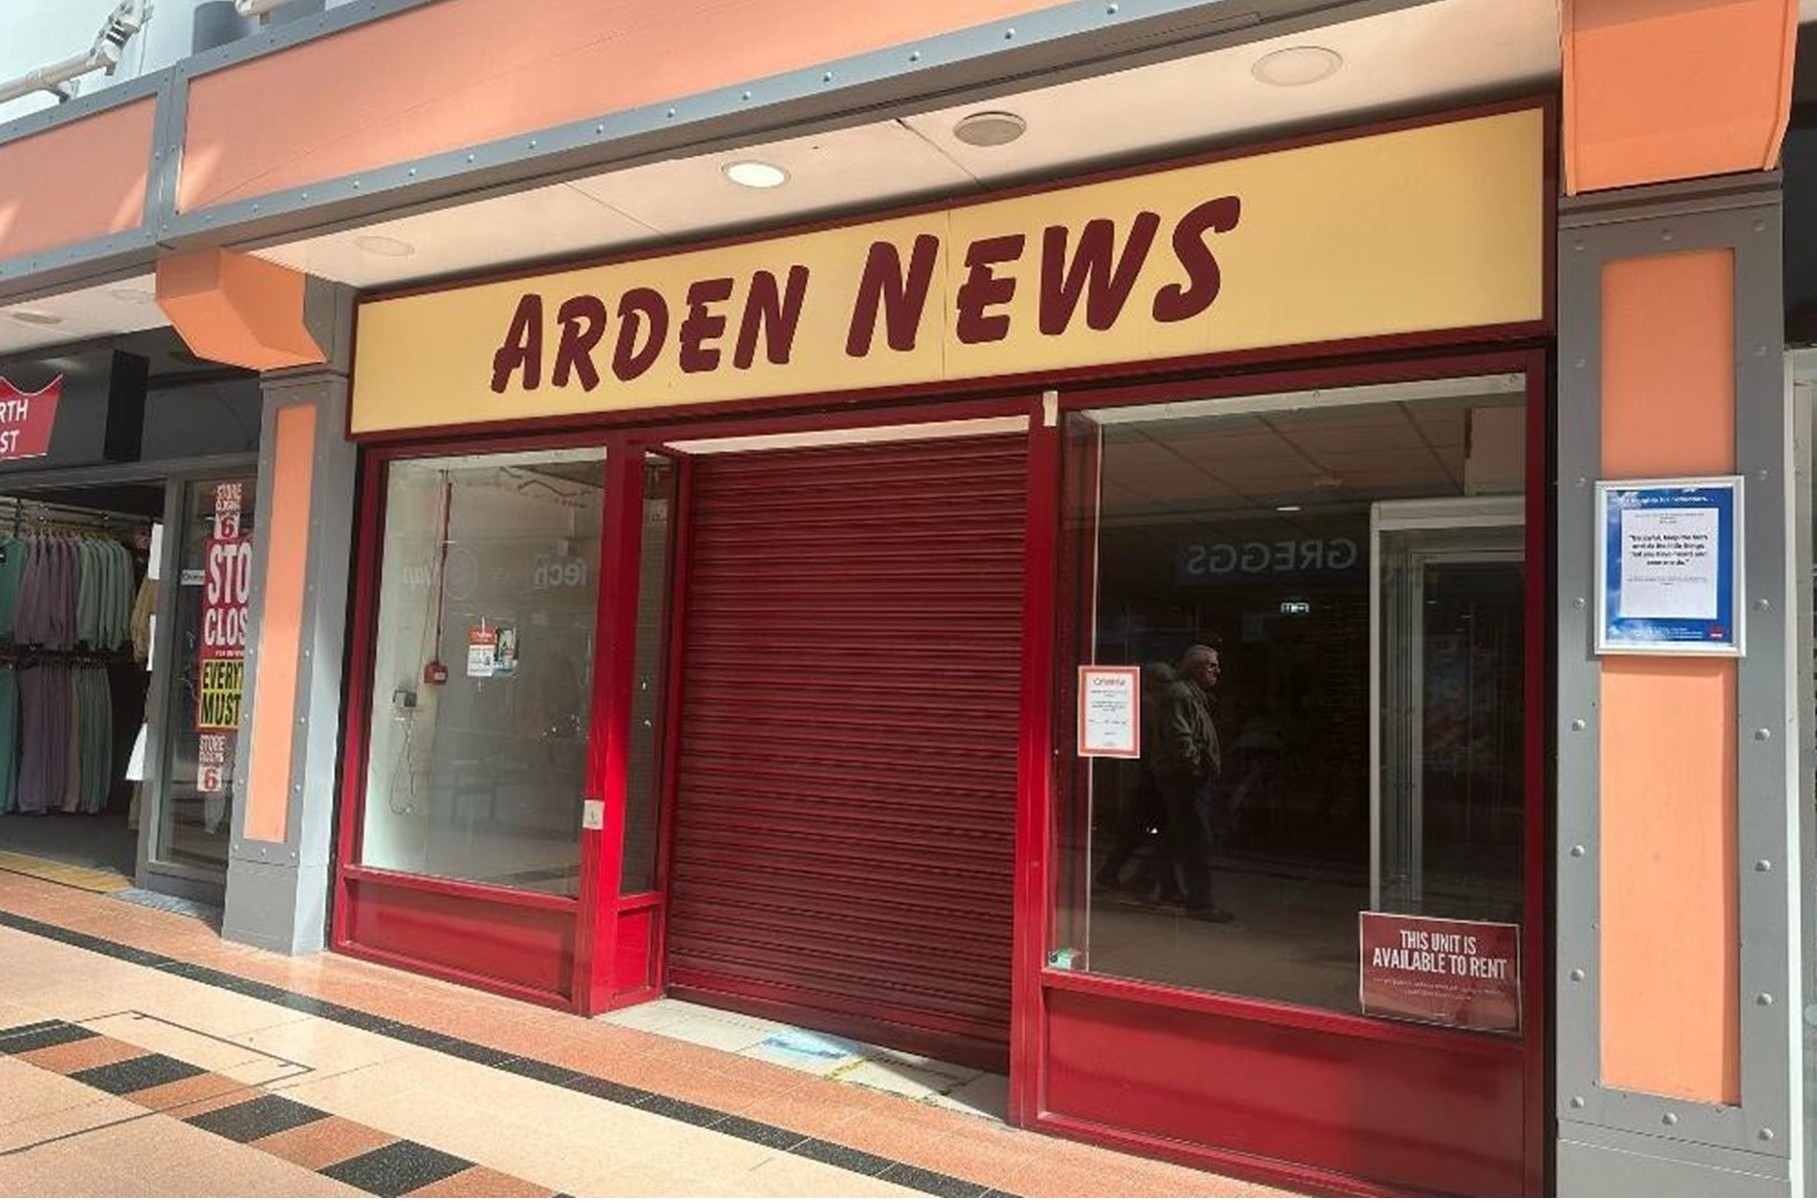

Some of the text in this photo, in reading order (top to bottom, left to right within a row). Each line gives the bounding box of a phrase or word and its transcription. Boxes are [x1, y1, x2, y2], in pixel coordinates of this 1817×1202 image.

[492, 196, 1241, 393] ARDEN NEWS
[221, 517, 235, 537] 6
[201, 692, 241, 726] MUST
[204, 769, 218, 789] 6
[1400, 930, 1477, 955] THIS UNIT IS
[1372, 947, 1508, 979] AVAILABLE TO RENT
